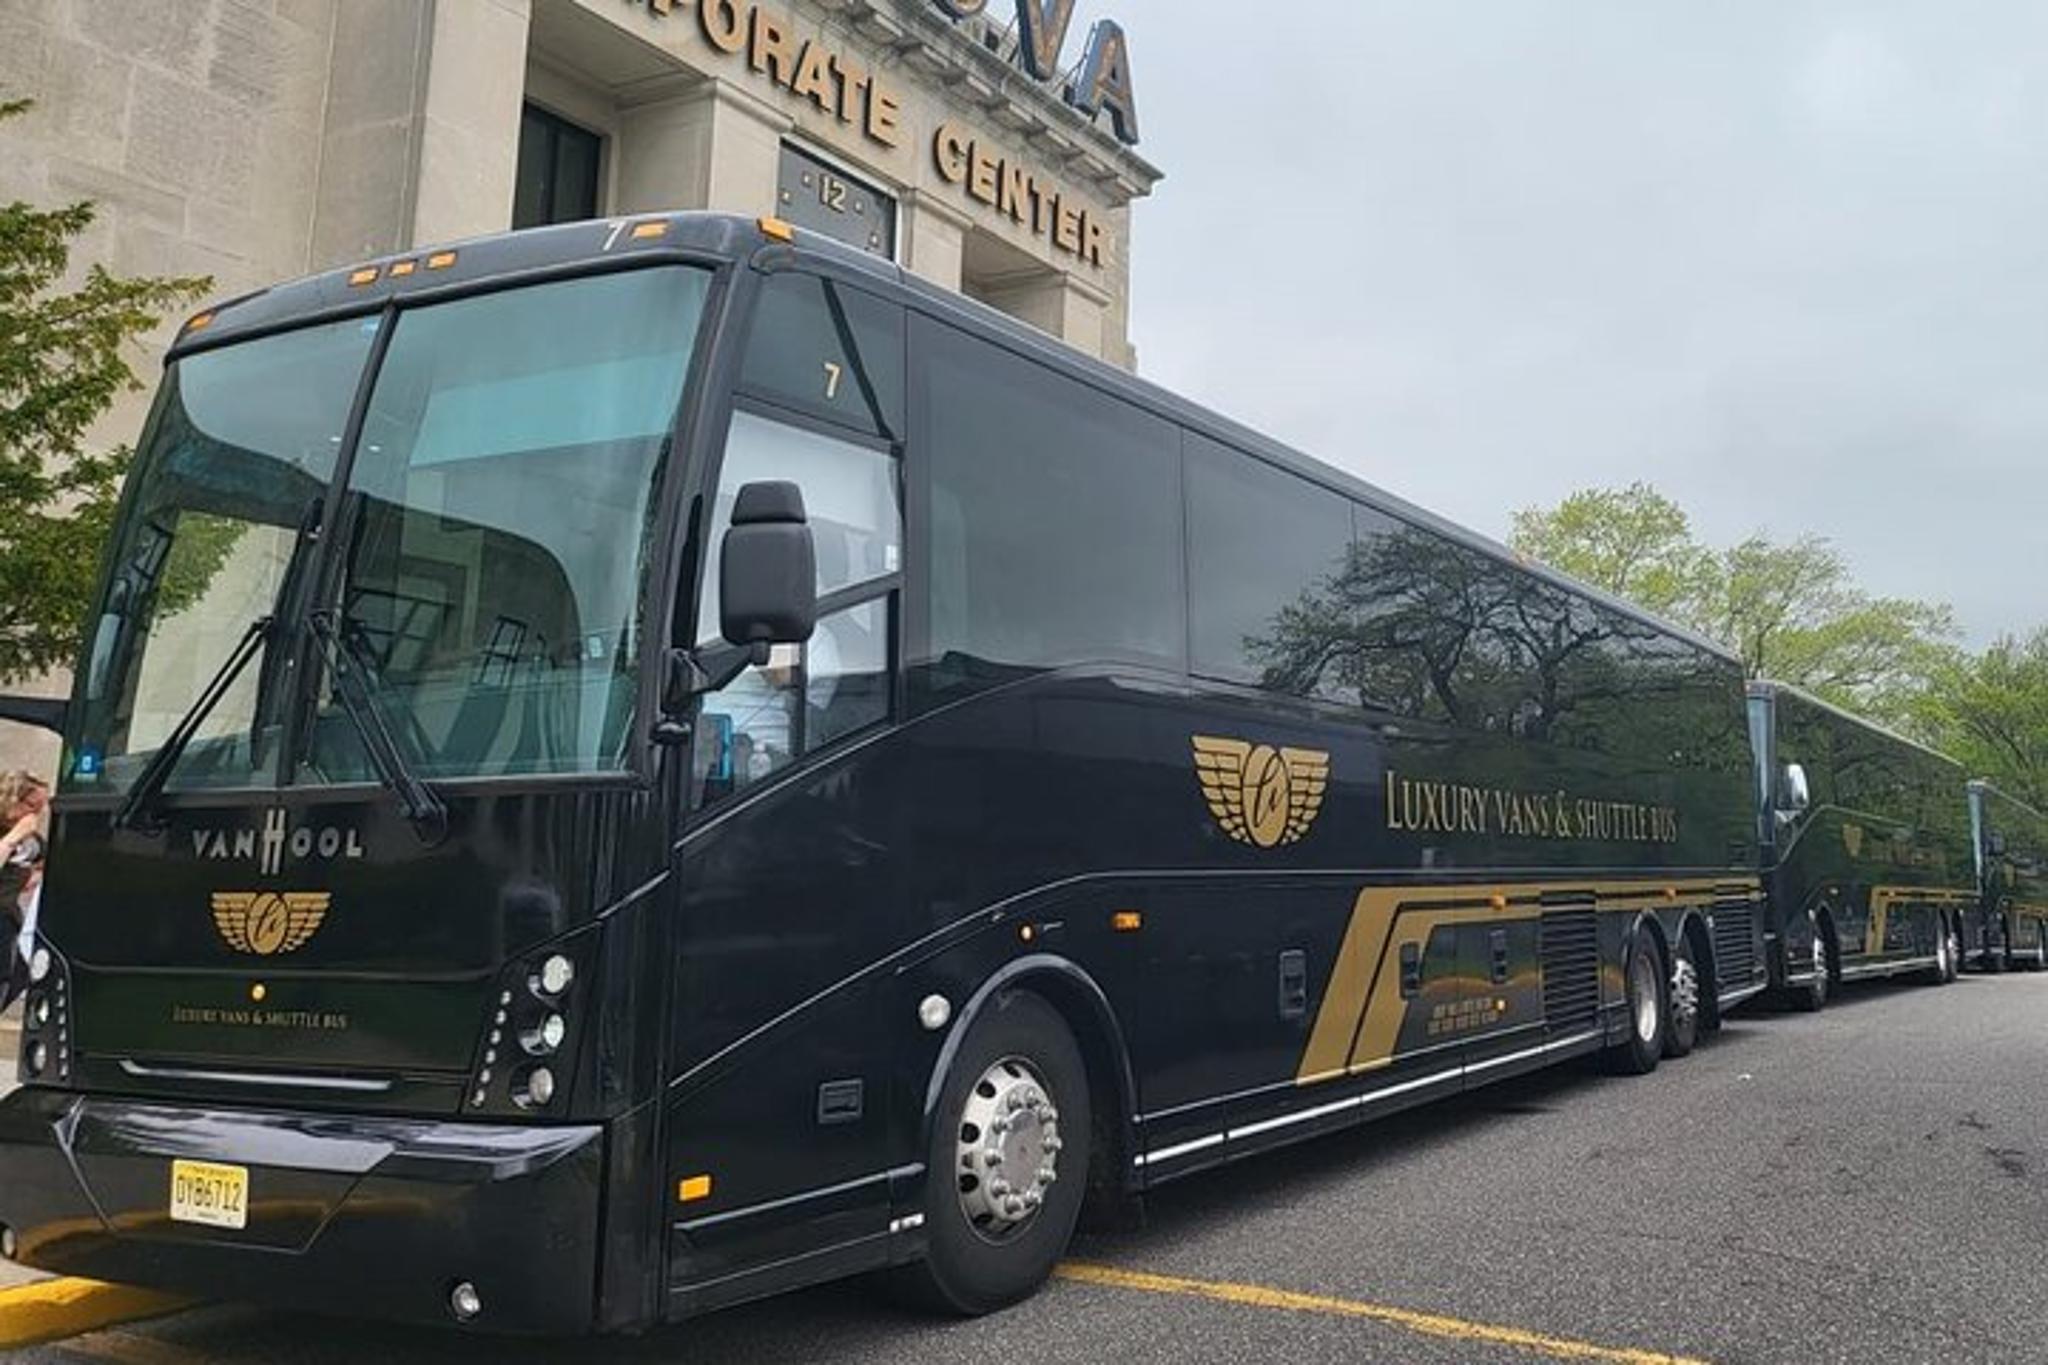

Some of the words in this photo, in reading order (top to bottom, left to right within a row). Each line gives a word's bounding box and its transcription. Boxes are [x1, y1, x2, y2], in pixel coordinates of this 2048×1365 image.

[932, 0, 1139, 145] VA
[648, 0, 900, 149] ORATE
[932, 116, 1117, 268] CENTER
[819, 173, 847, 214] 12
[603, 217, 627, 251] 7
[824, 362, 840, 399] 7
[1385, 769, 1489, 834] LUXURY
[1496, 789, 1549, 837] VANS
[1554, 789, 1572, 838] &
[1576, 798, 1648, 841] SHUTTLE
[1651, 805, 1677, 843] BUS
